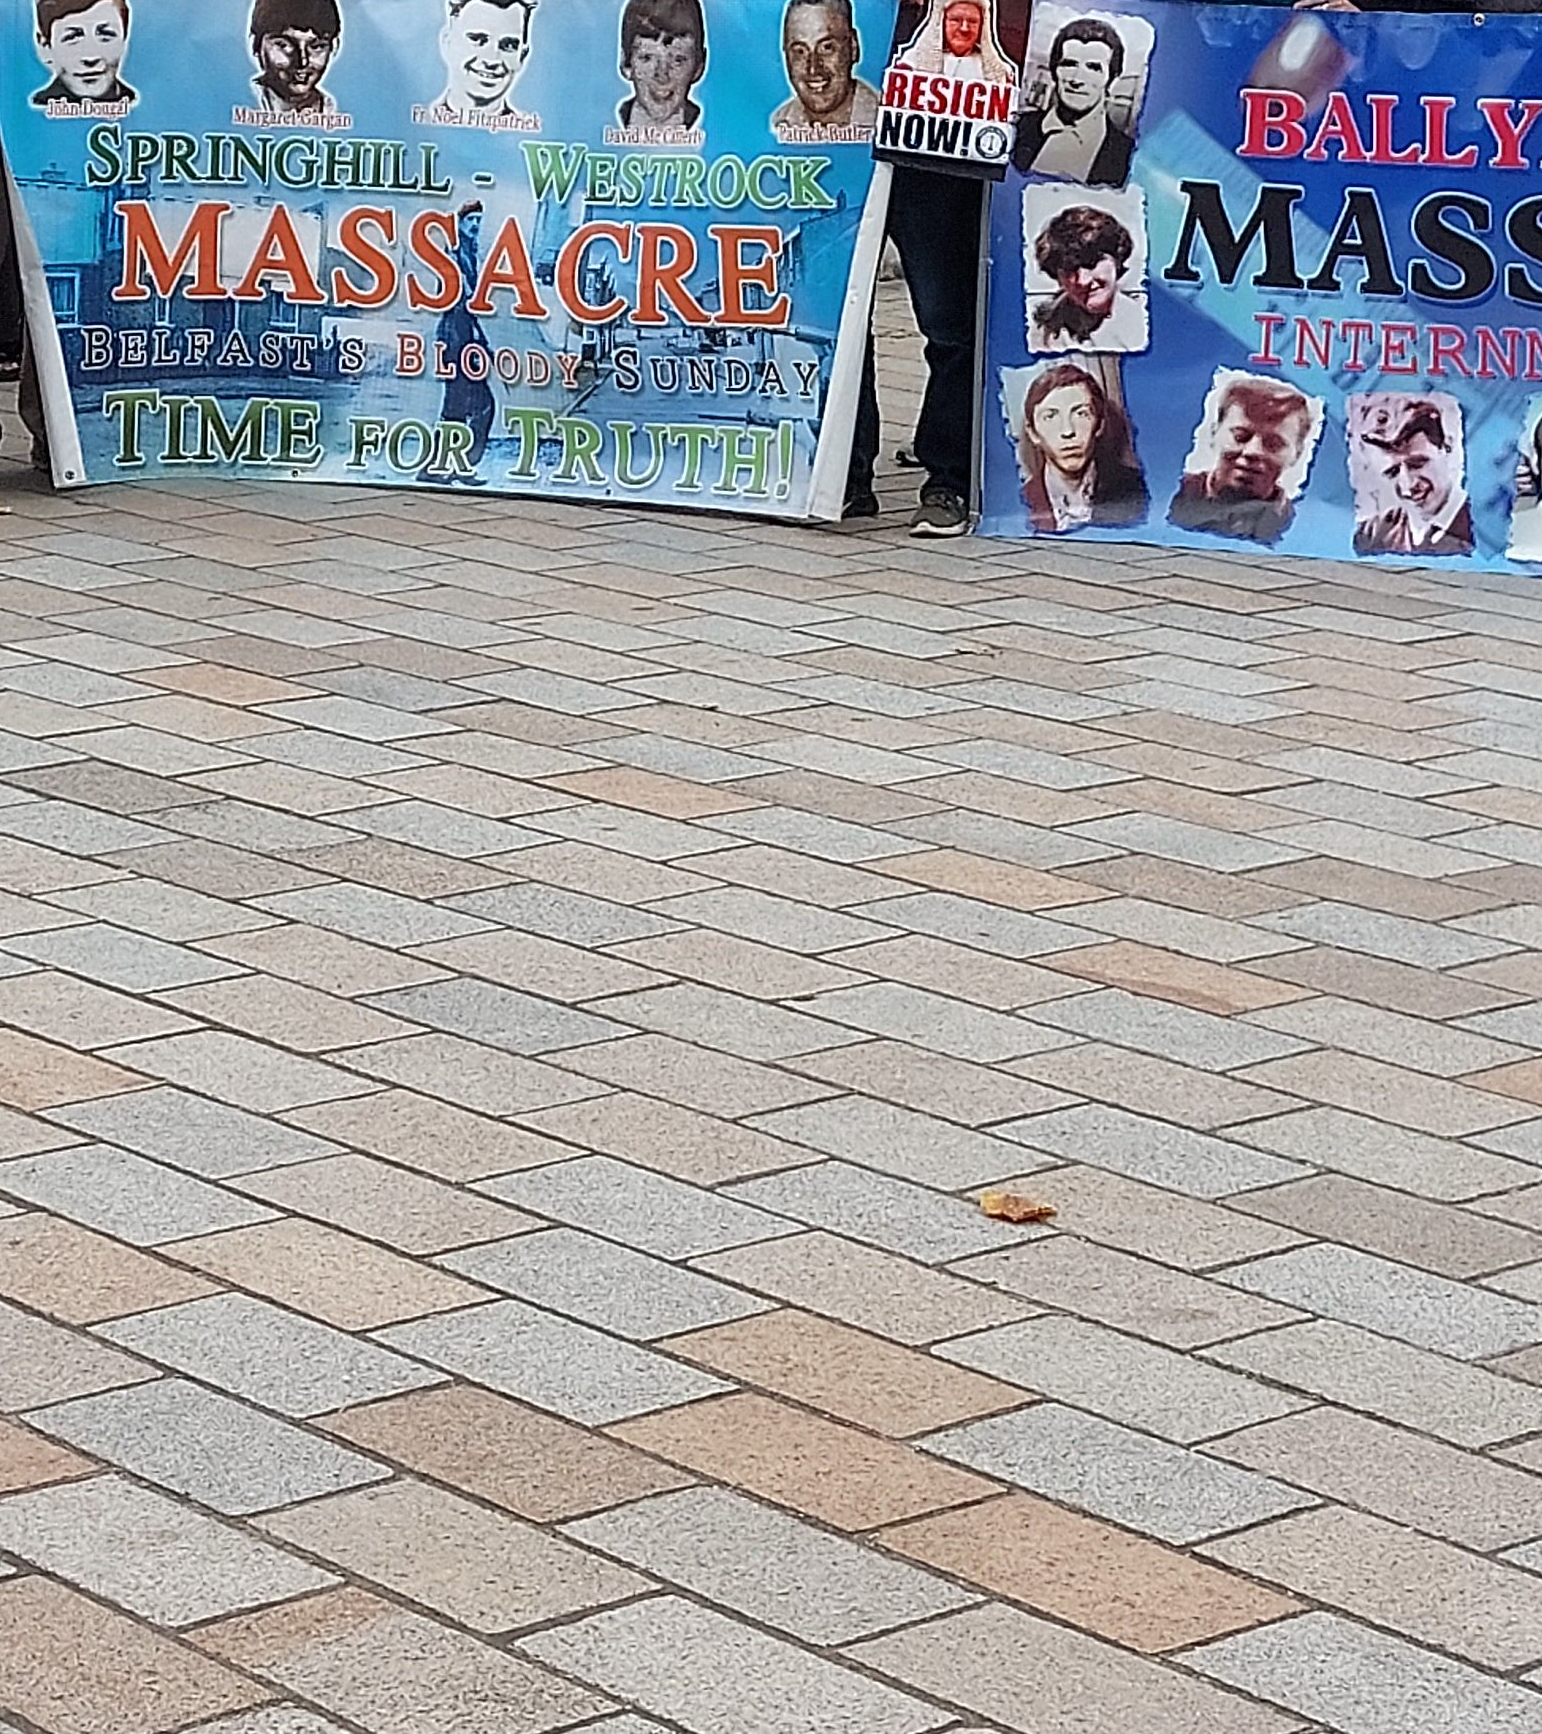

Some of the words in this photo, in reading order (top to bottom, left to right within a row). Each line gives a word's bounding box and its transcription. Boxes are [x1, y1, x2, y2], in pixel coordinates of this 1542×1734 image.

[885, 71, 1012, 123] RESIGN
[879, 110, 973, 157] NOW!
[114, 201, 789, 329] MASSACRE
[81, 326, 367, 372] BELFAST'S
[104, 390, 323, 466] TIME
[348, 417, 475, 474] FOR
[503, 408, 793, 499] TRUTH!
